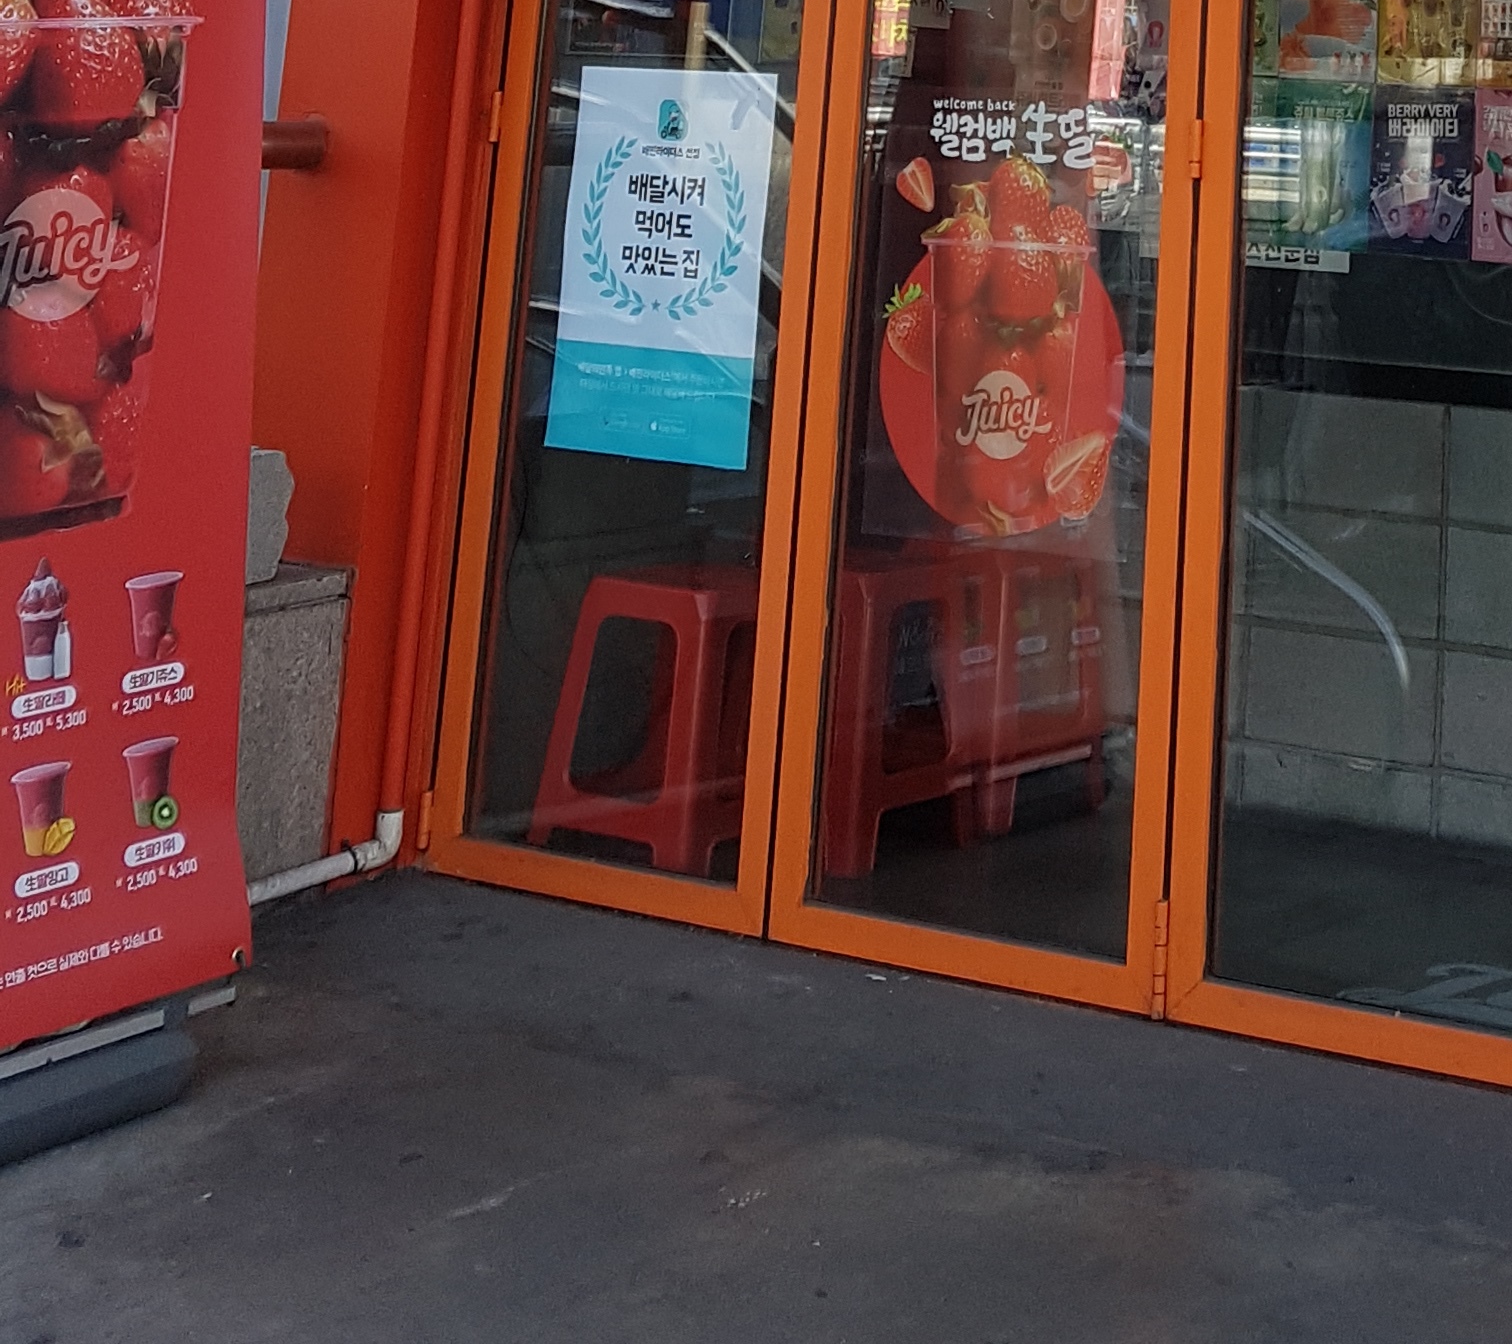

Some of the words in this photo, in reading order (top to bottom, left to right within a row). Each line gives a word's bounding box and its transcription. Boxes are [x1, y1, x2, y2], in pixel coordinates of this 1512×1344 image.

[933, 97, 984, 111] welcome
[987, 98, 1016, 111] back
[1387, 103, 1425, 118] BERRY
[1427, 103, 1459, 118] VERY
[628, 173, 706, 207] 배달시켜
[634, 209, 693, 240] 먹어도
[621, 245, 678, 277] 맛있는
[682, 249, 701, 280] 집
[955, 388, 1052, 447] Juicy
